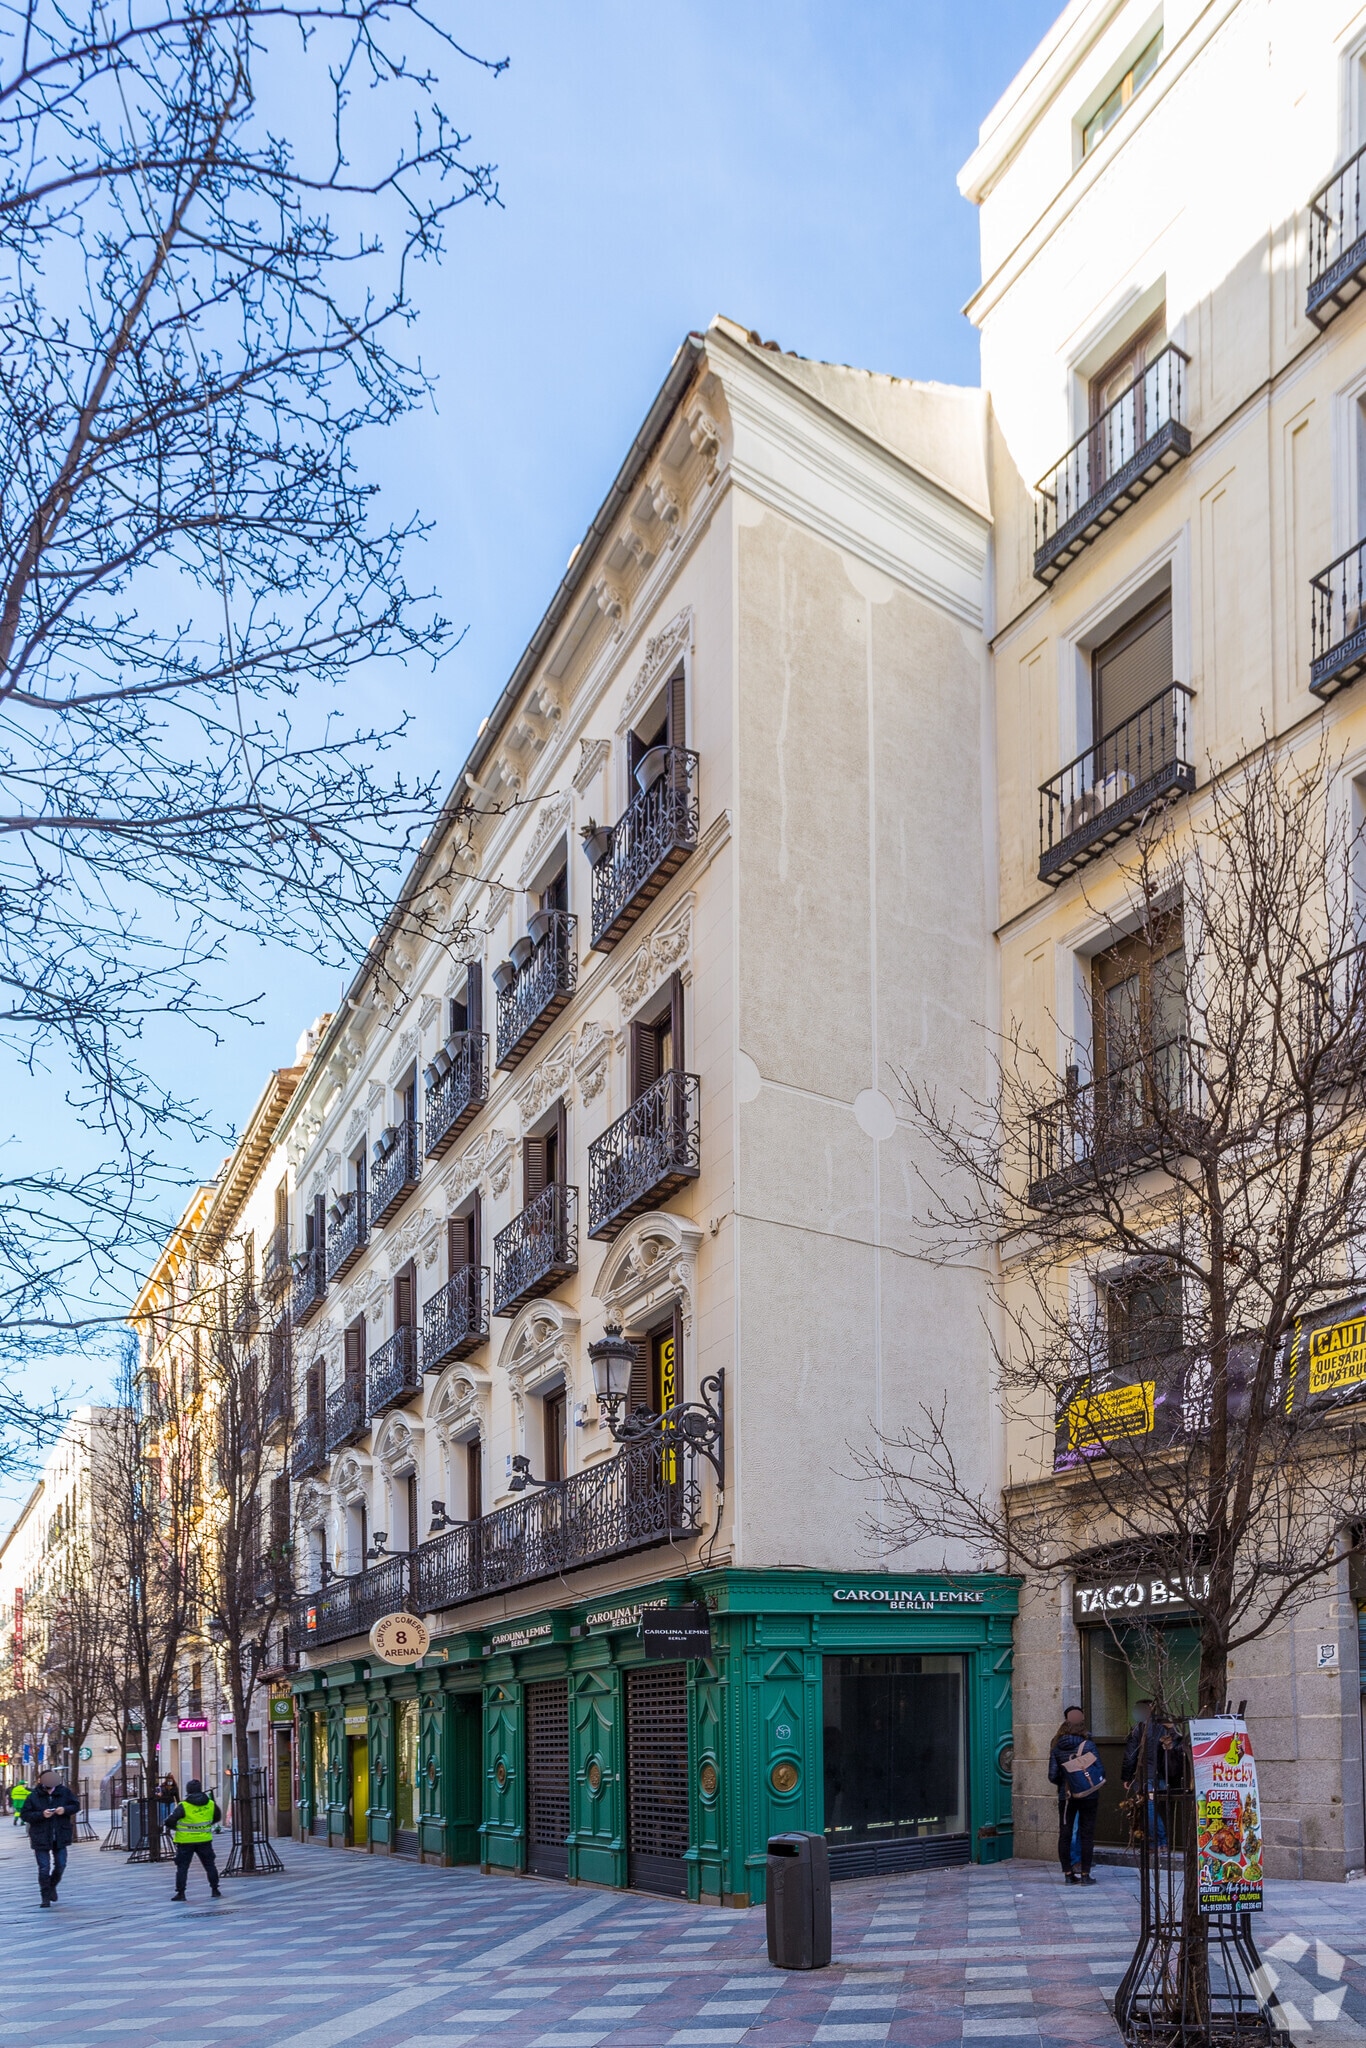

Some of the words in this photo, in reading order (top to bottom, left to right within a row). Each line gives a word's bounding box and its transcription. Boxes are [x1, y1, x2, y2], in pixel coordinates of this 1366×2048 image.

[1317, 1323, 1366, 1354] CAUT
[1316, 1348, 1366, 1374] QUESARI
[833, 1589, 925, 1601] CAROLINA
[929, 1591, 985, 1602] LEMKE
[1076, 1583, 1145, 1613] TACO
[890, 1601, 934, 1610] BERLIN
[586, 1605, 632, 1625] CAROLINA
[376, 1620, 392, 1648] CENTRO
[395, 1616, 427, 1645] COMERCIAL
[395, 1631, 408, 1644] 8
[492, 1629, 525, 1644] CAROLINA
[526, 1624, 552, 1637] LEMKE
[511, 1638, 530, 1648] BERLIN
[384, 1647, 422, 1657] ARENAL
[1212, 1763, 1253, 1787] Rocky
[1208, 1791, 1238, 1802] ¡OFERTA!
[1207, 1806, 1221, 1815] 20€
